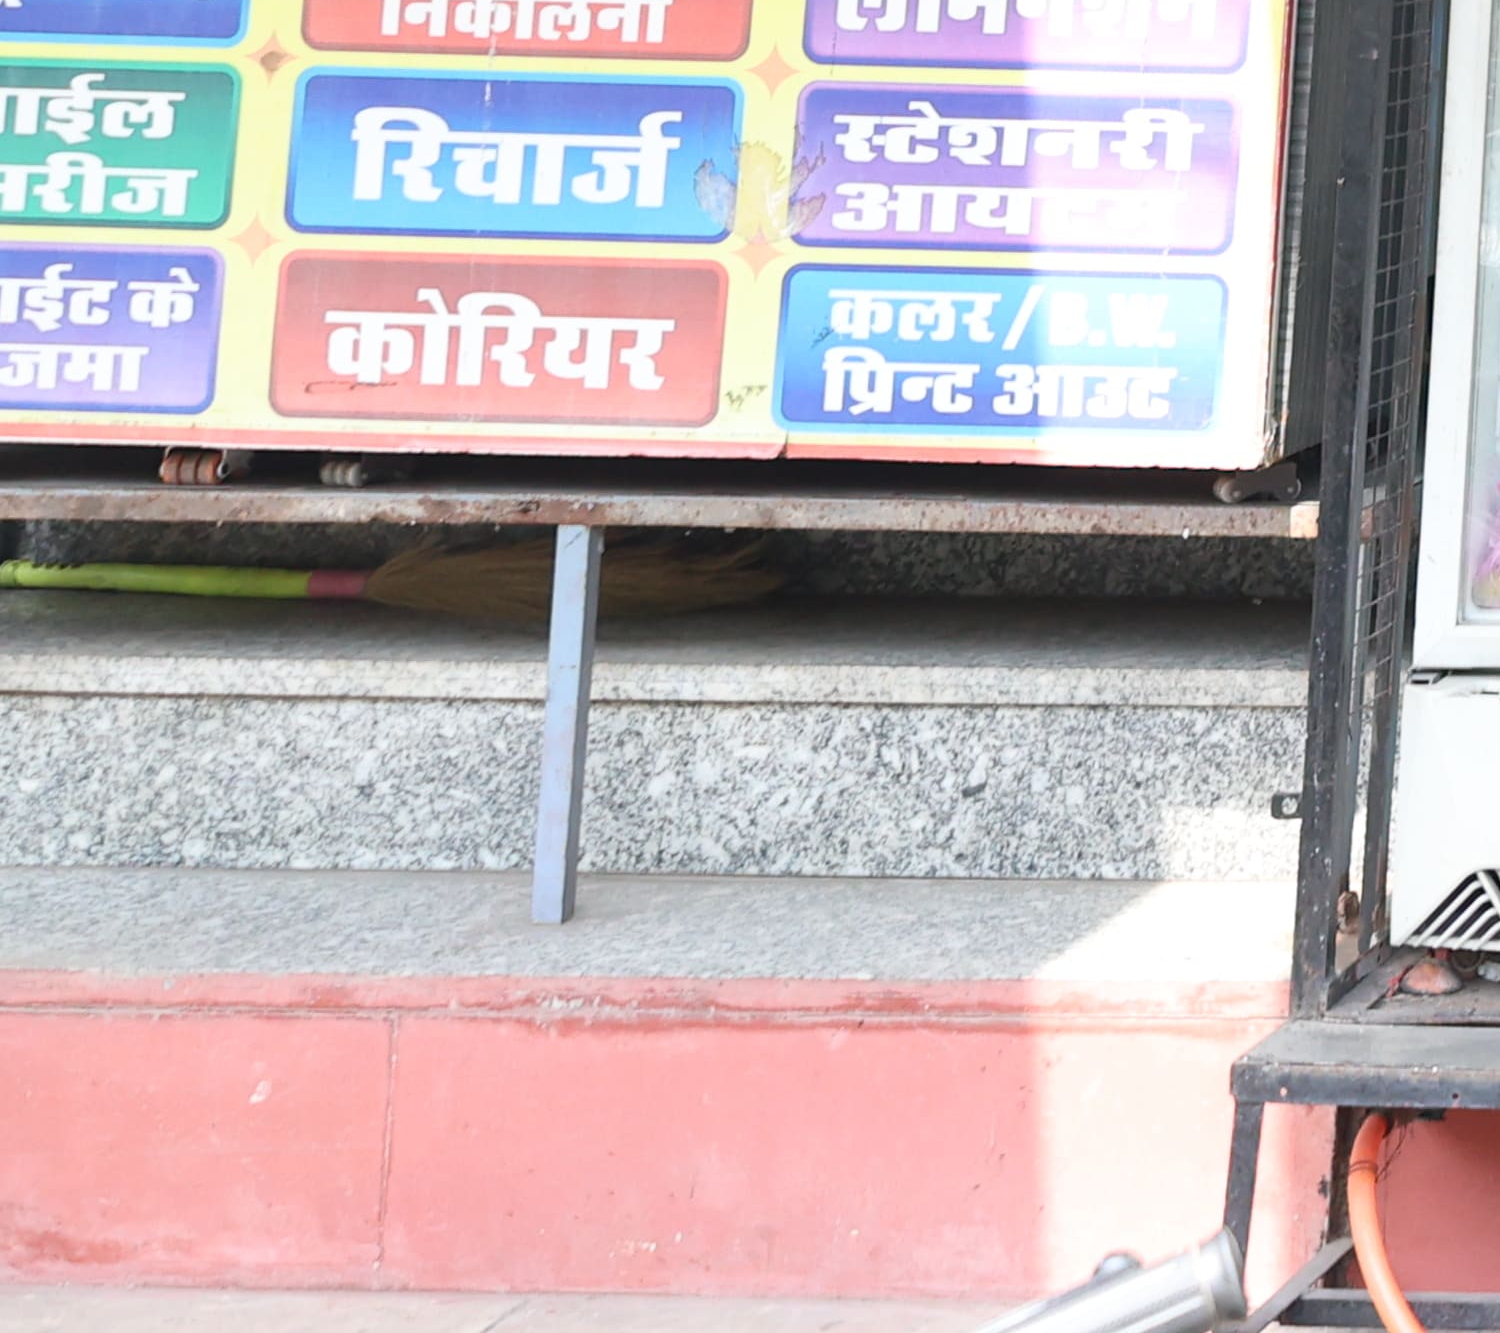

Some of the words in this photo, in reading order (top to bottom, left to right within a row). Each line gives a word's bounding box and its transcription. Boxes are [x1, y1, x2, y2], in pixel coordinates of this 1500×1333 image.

[350, 106, 682, 209] रिचार्ज
[833, 101, 1205, 172] स्टेशनरी
[127, 267, 199, 328] के
[324, 287, 675, 392] कोरियर
[822, 347, 981, 416] प्रिन्ट
[993, 363, 1178, 420] आउट
